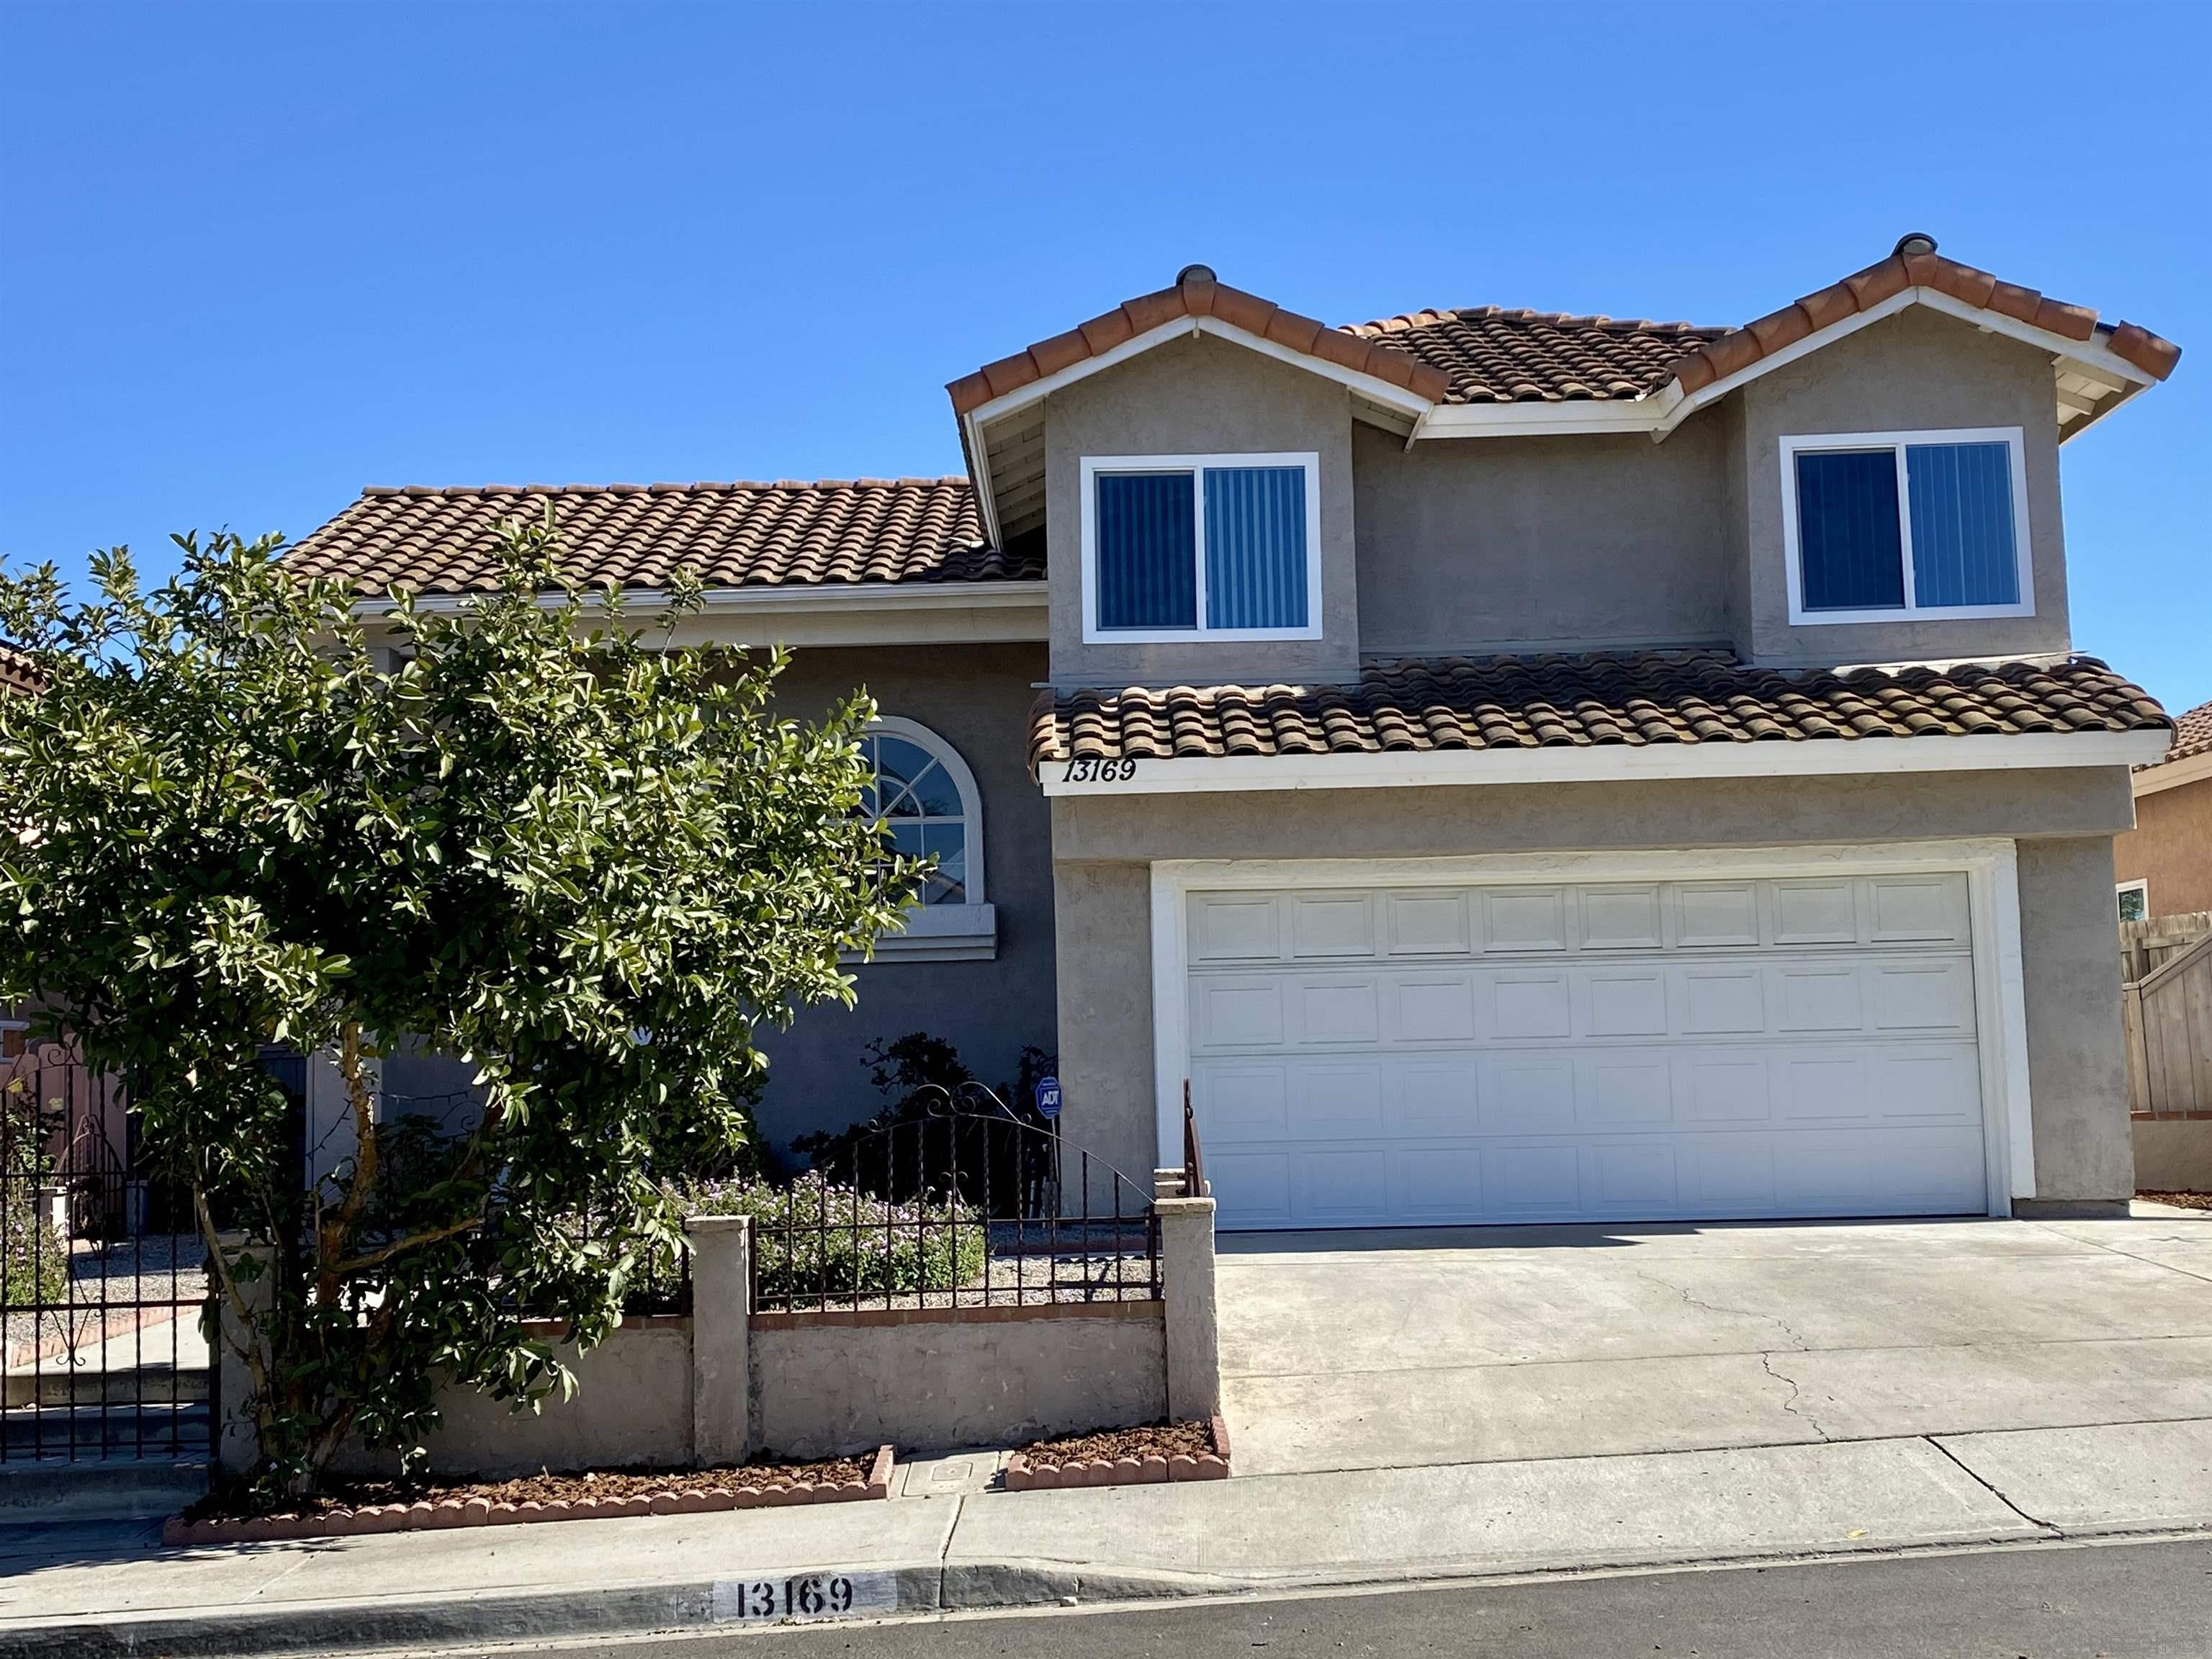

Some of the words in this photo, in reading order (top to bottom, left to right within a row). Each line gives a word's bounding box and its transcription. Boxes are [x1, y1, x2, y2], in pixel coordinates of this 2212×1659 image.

[1062, 760, 1136, 782] 13169
[1042, 1091, 1059, 1105] ADT
[737, 1578, 853, 1618] 13169
